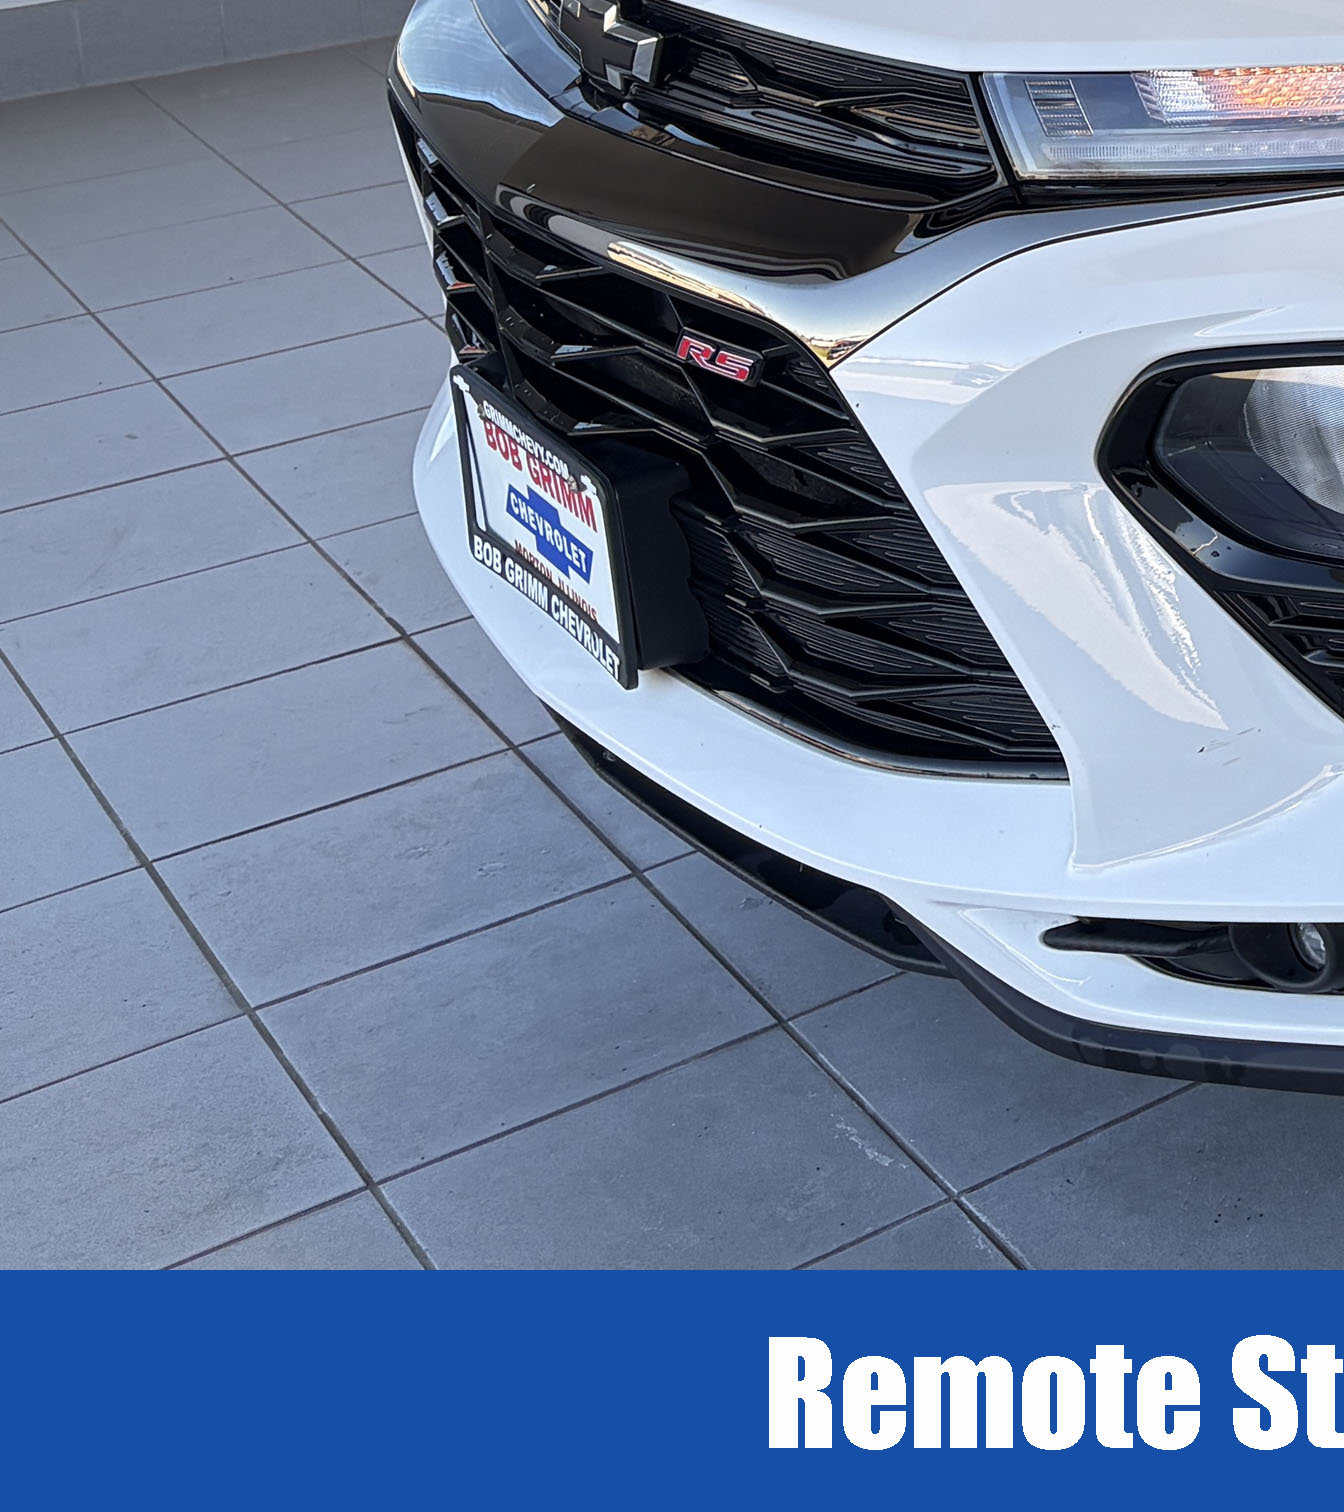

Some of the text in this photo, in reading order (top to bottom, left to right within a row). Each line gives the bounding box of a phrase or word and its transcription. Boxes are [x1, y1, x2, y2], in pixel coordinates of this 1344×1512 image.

[676, 333, 755, 383] RS
[482, 400, 570, 478] GRIMMCHEVY.COM
[484, 419, 598, 533] BOB GRIMM
[510, 490, 586, 574] CHEVROLET
[473, 535, 620, 680] BOB GRIMM CHEVROLET
